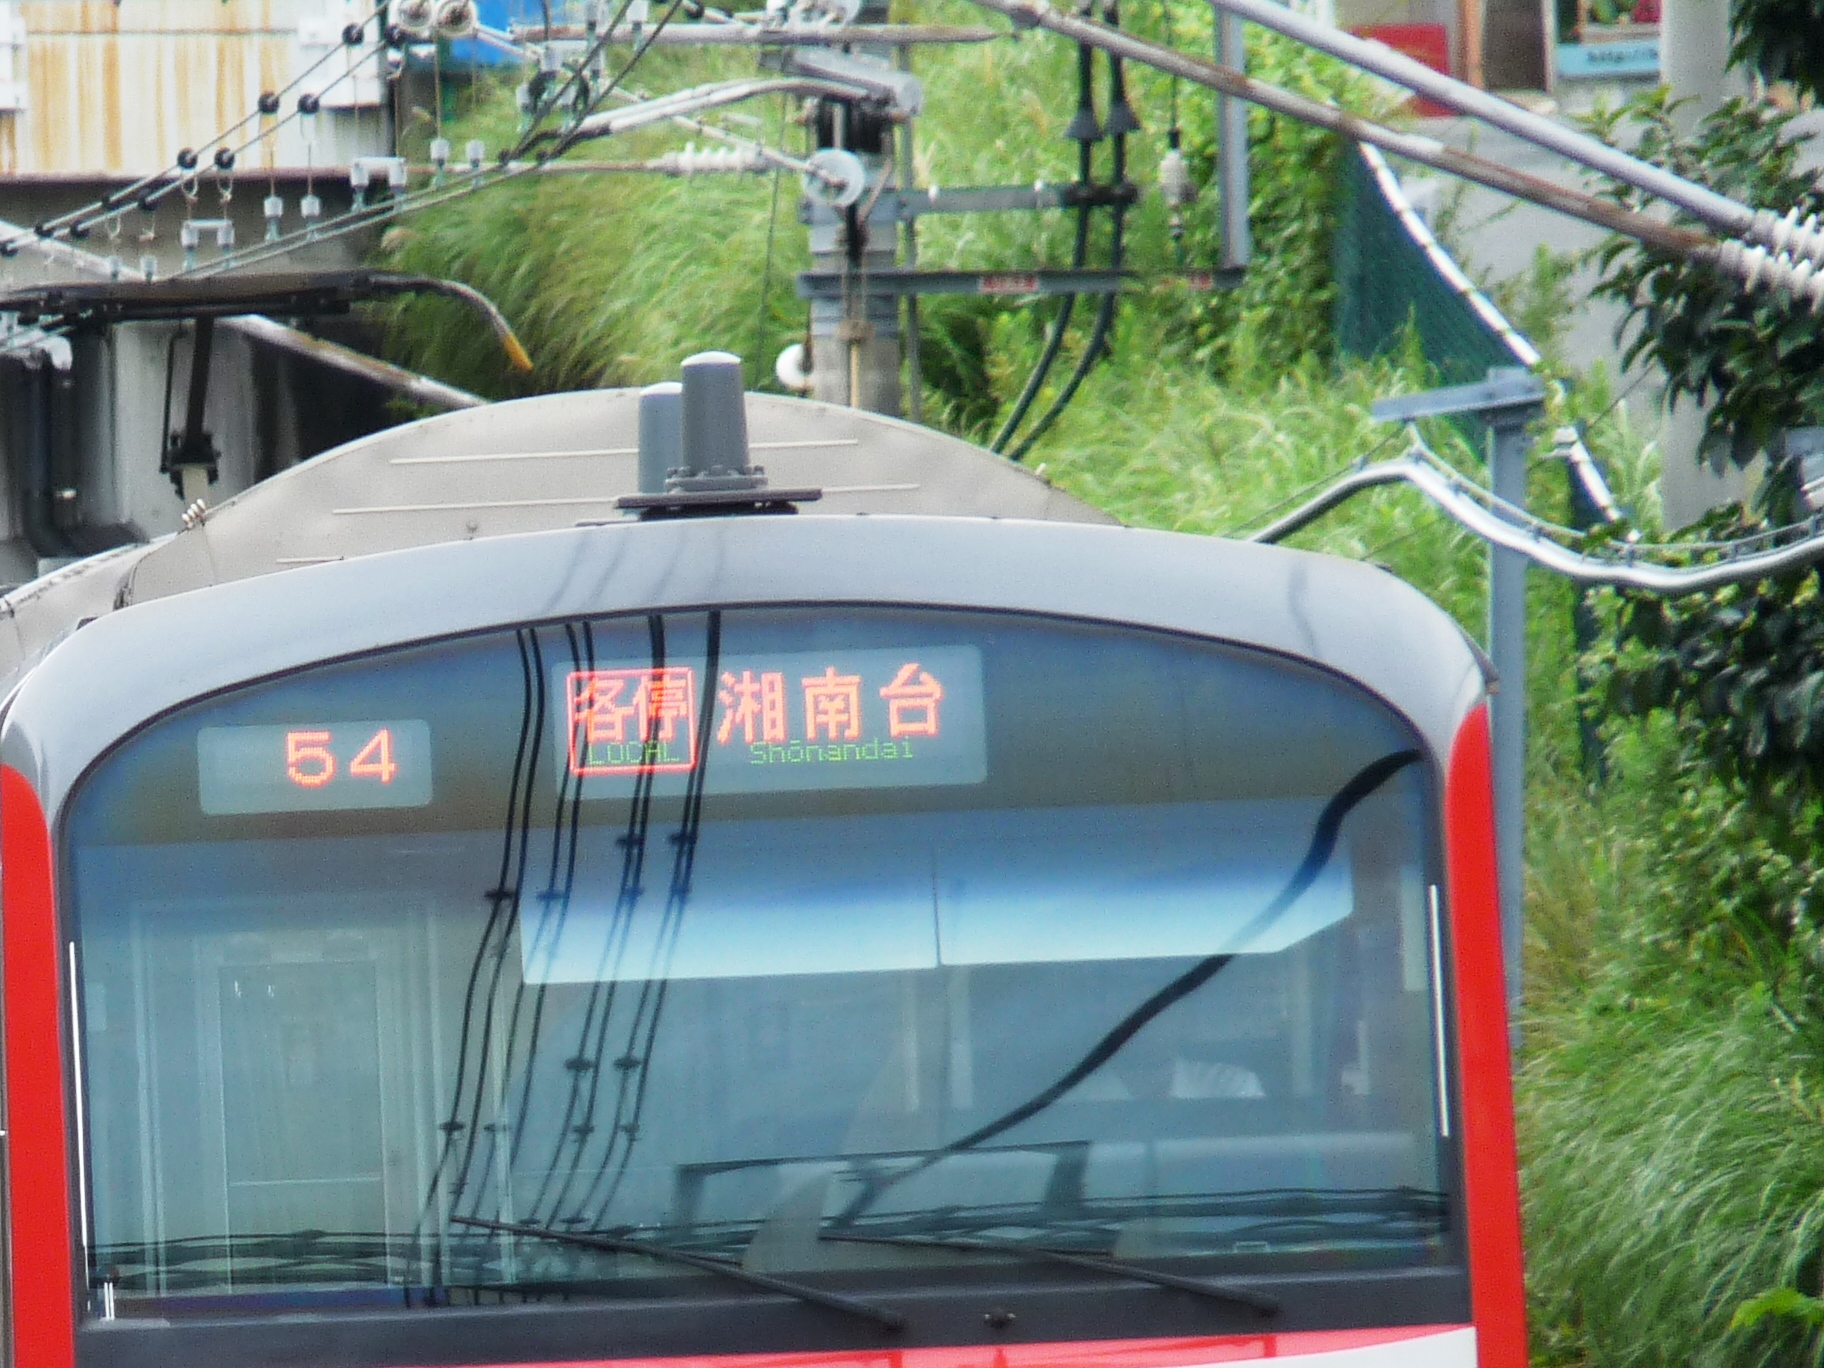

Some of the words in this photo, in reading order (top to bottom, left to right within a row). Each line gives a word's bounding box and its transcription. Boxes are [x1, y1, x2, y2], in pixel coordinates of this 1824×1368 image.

[573, 674, 688, 743] 各停
[716, 662, 944, 744] 湘南台
[286, 728, 398, 787] 54
[588, 740, 681, 766] LOCAL
